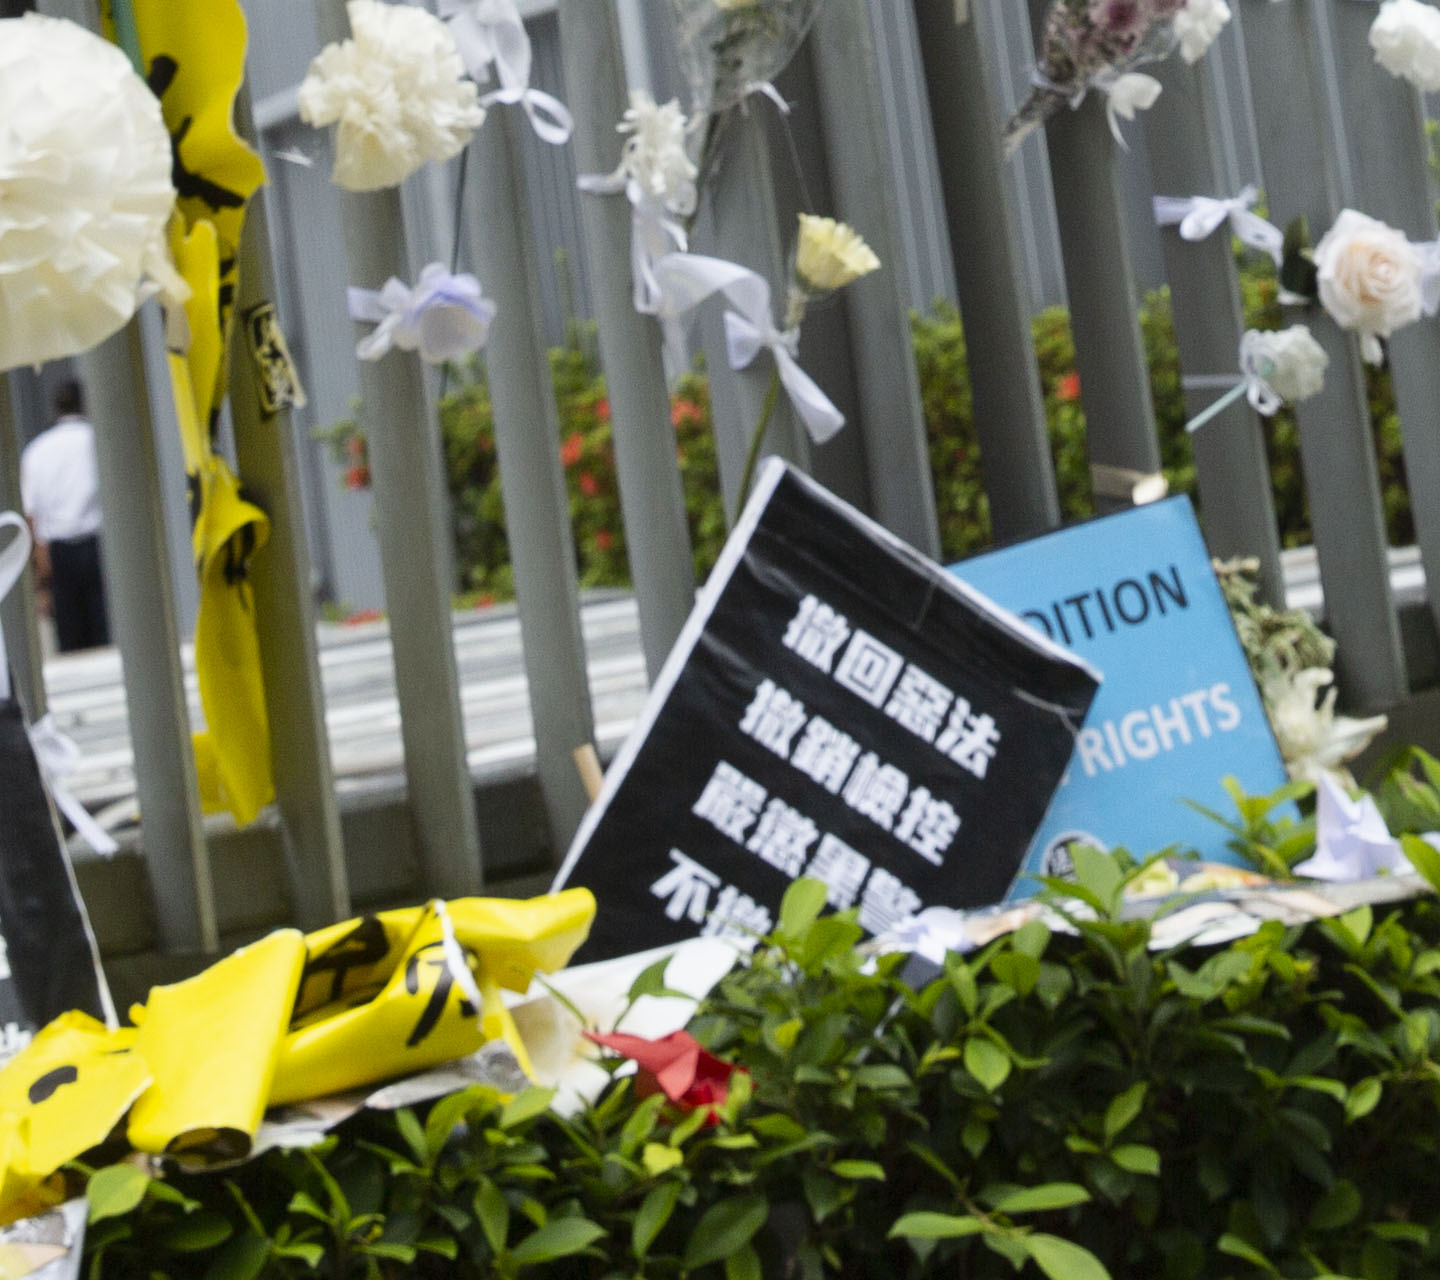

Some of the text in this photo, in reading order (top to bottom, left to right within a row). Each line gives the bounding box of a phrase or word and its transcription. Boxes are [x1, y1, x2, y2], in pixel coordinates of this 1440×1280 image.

[738, 678, 962, 867] 撤銷檢控
[781, 592, 1002, 781] 撤回惡法
[1077, 682, 1242, 778] RIGHTS
